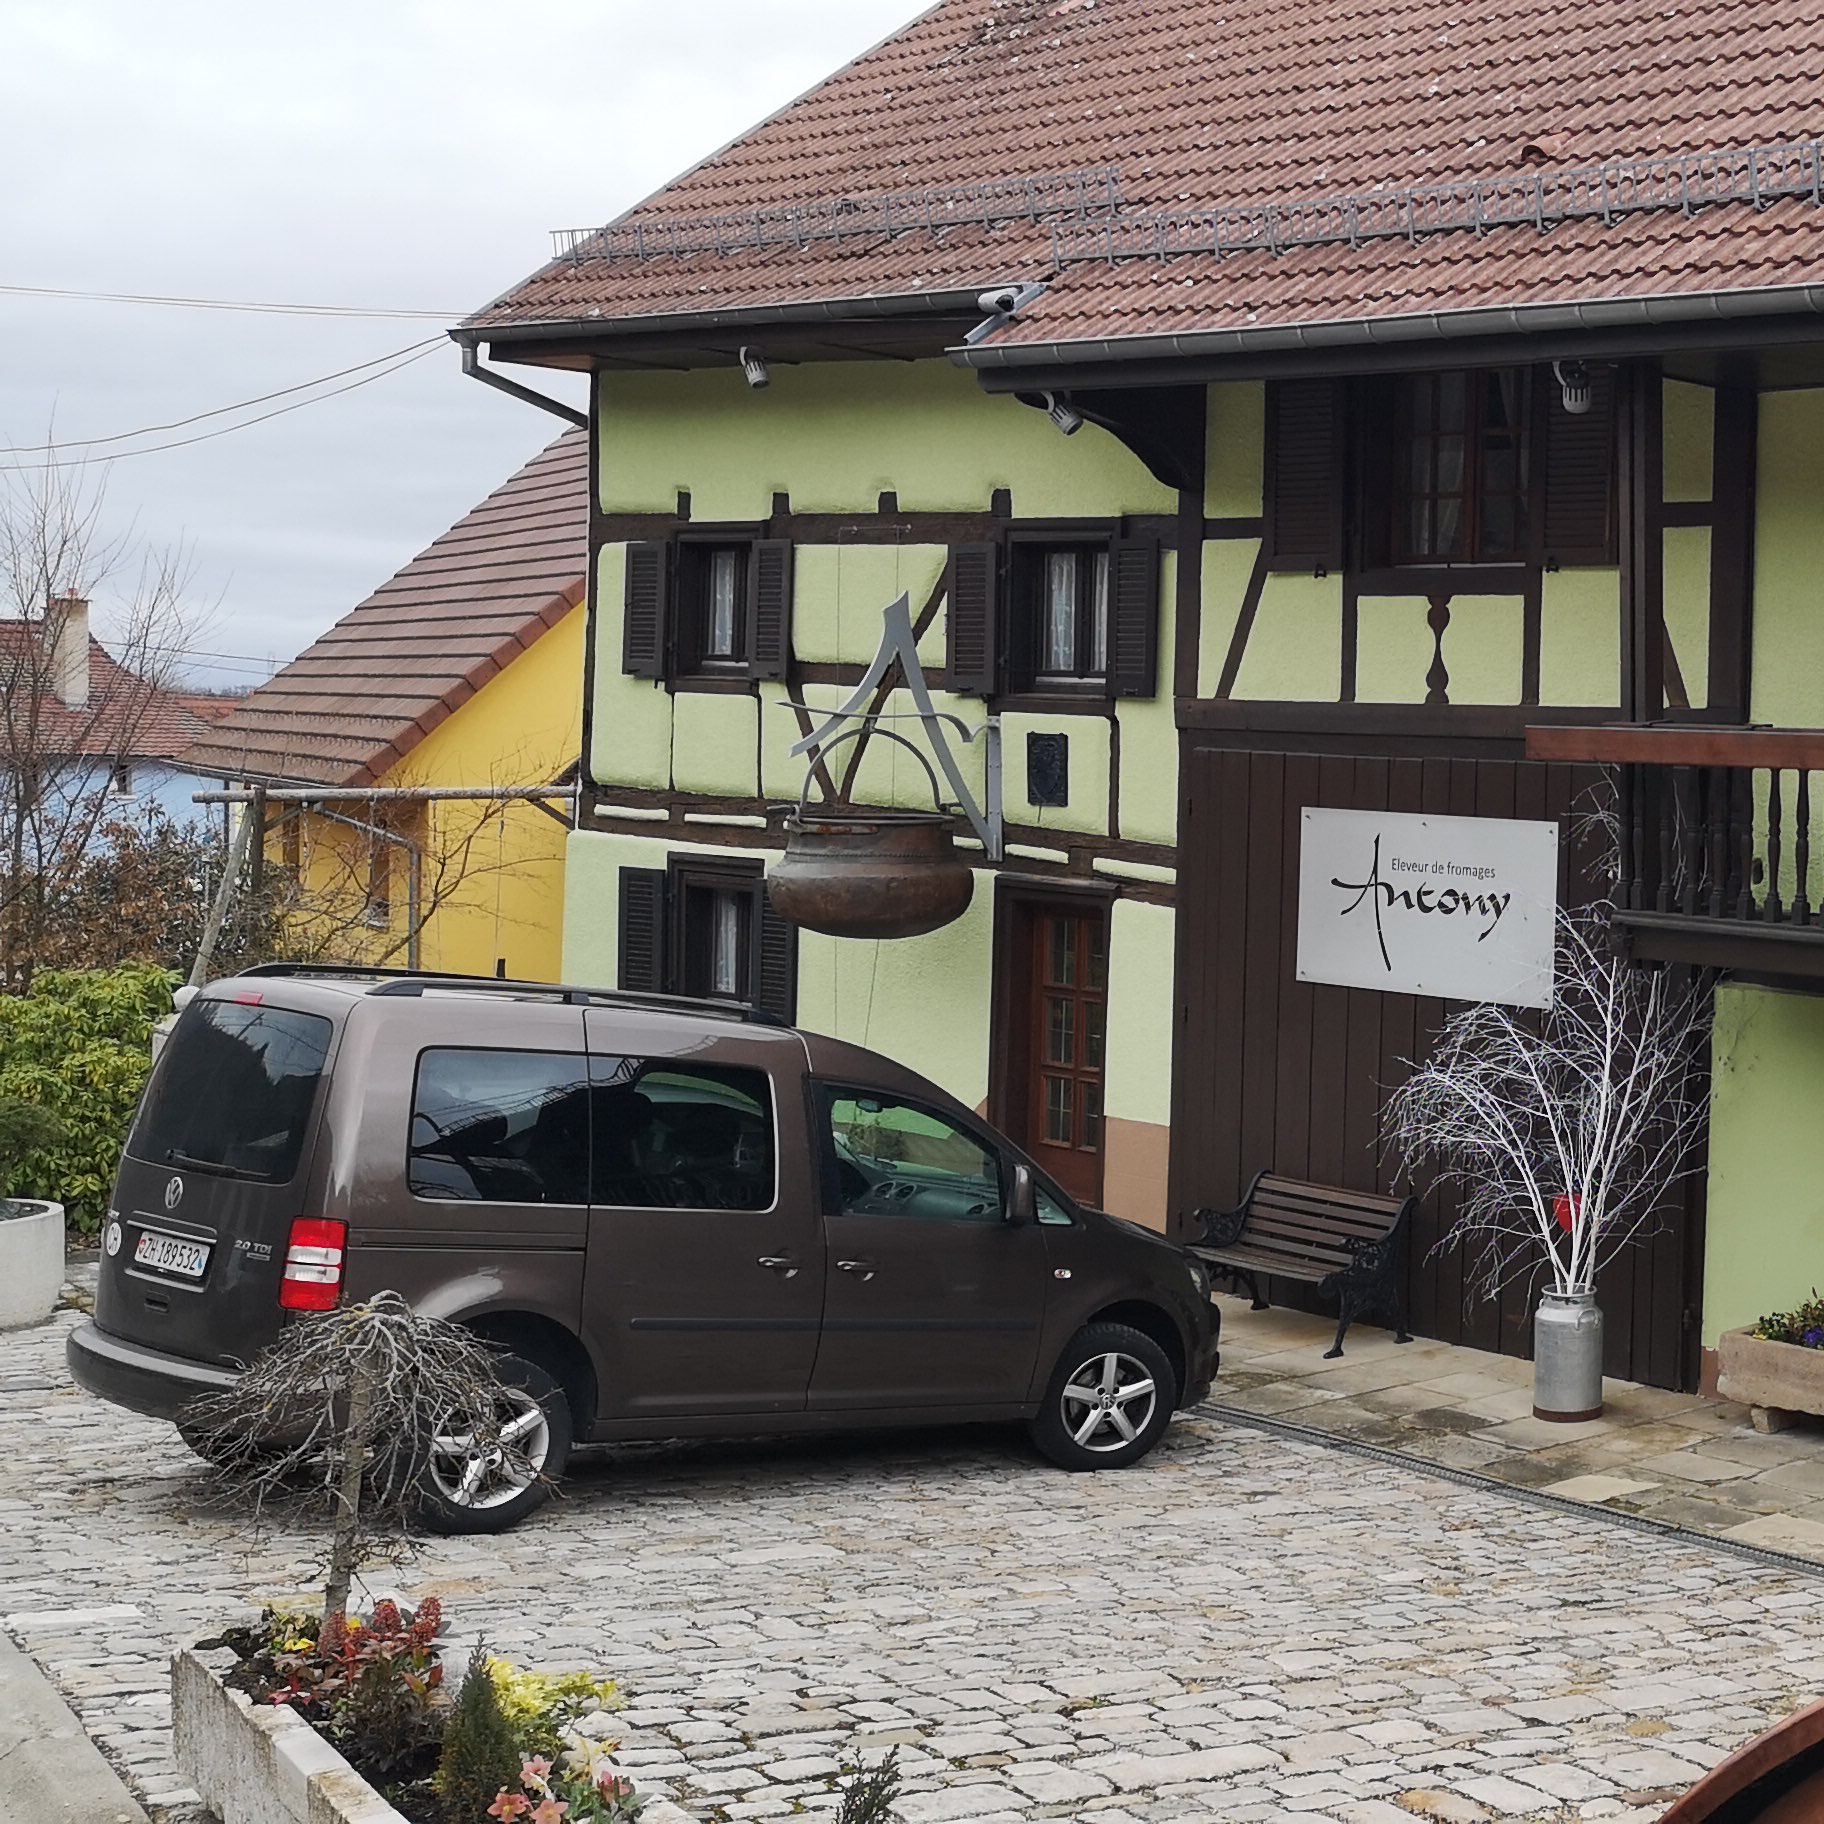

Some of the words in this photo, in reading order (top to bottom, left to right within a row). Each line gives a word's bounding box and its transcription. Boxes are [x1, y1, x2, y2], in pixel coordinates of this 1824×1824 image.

[1391, 857, 1429, 873] Eleveur
[1431, 860, 1445, 875] de
[1447, 861, 1496, 881] fromages
[1330, 832, 1511, 972] Antony
[253, 1242, 273, 1255] TDI
